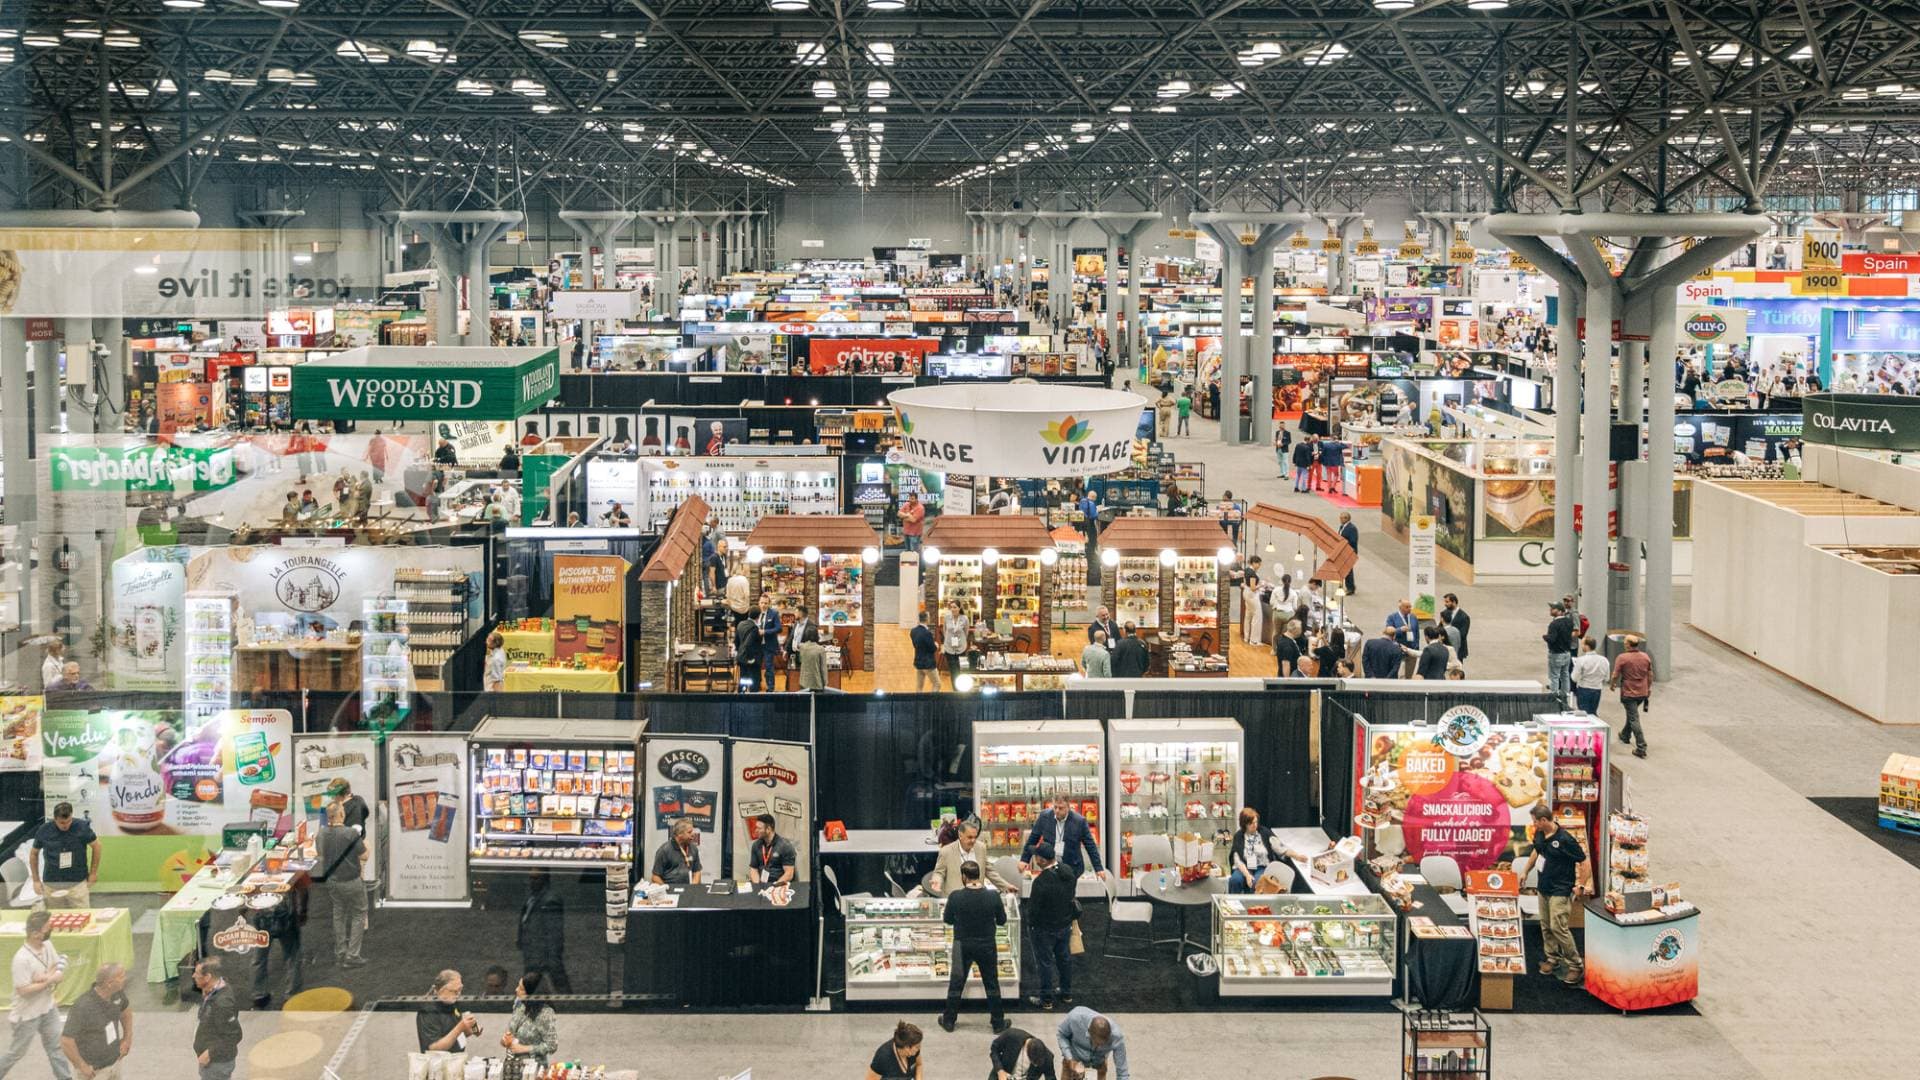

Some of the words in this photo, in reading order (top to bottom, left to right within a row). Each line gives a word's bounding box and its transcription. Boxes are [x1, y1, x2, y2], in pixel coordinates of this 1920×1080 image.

[1451, 251, 1473, 259] 2300
[1807, 241, 1838, 259] 1900
[1512, 256, 1529, 264] 220
[1864, 257, 1908, 273] Spain
[1807, 275, 1837, 287] 1900
[1686, 285, 1723, 300] Spain
[1686, 322, 1726, 332] POLLY-O
[522, 362, 555, 404] WOODLAND
[327, 378, 482, 408] WOODLAND
[366, 393, 450, 408] FOODS
[1813, 412, 1896, 433] COLAVITA
[1765, 426, 1804, 434] MAMA'S
[476, 431, 492, 446] FREE
[1043, 440, 1130, 465] VINTAGE
[899, 469, 919, 477] SMALL
[899, 477, 919, 485] BATCH
[899, 485, 921, 493] SIMPLE
[899, 493, 940, 501] INGIENTS
[269, 568, 281, 580] LA
[282, 556, 347, 580] TOURANGELLE
[559, 567, 599, 577] DISCOVER
[602, 566, 617, 575] THE
[121, 569, 173, 596] Tourangelle
[559, 575, 594, 585] AUTHENTIC
[596, 574, 617, 583] TASTE
[570, 583, 611, 595] MEXICO!
[241, 713, 277, 725] Sempio
[44, 725, 107, 756] Yondu
[664, 752, 704, 765] LASCCO
[1405, 758, 1446, 773] BAKED
[744, 767, 768, 779] OCEAN
[769, 767, 795, 782] BEAUTY
[115, 779, 161, 808] Yondu
[1422, 803, 1493, 816] SNACKALICIOUS
[1433, 817, 1468, 827] naked
[1421, 828, 1453, 842] FULLY
[1453, 828, 1492, 842] LOADED
[217, 930, 240, 942] OCEAN
[240, 931, 267, 942] BEAUTY
